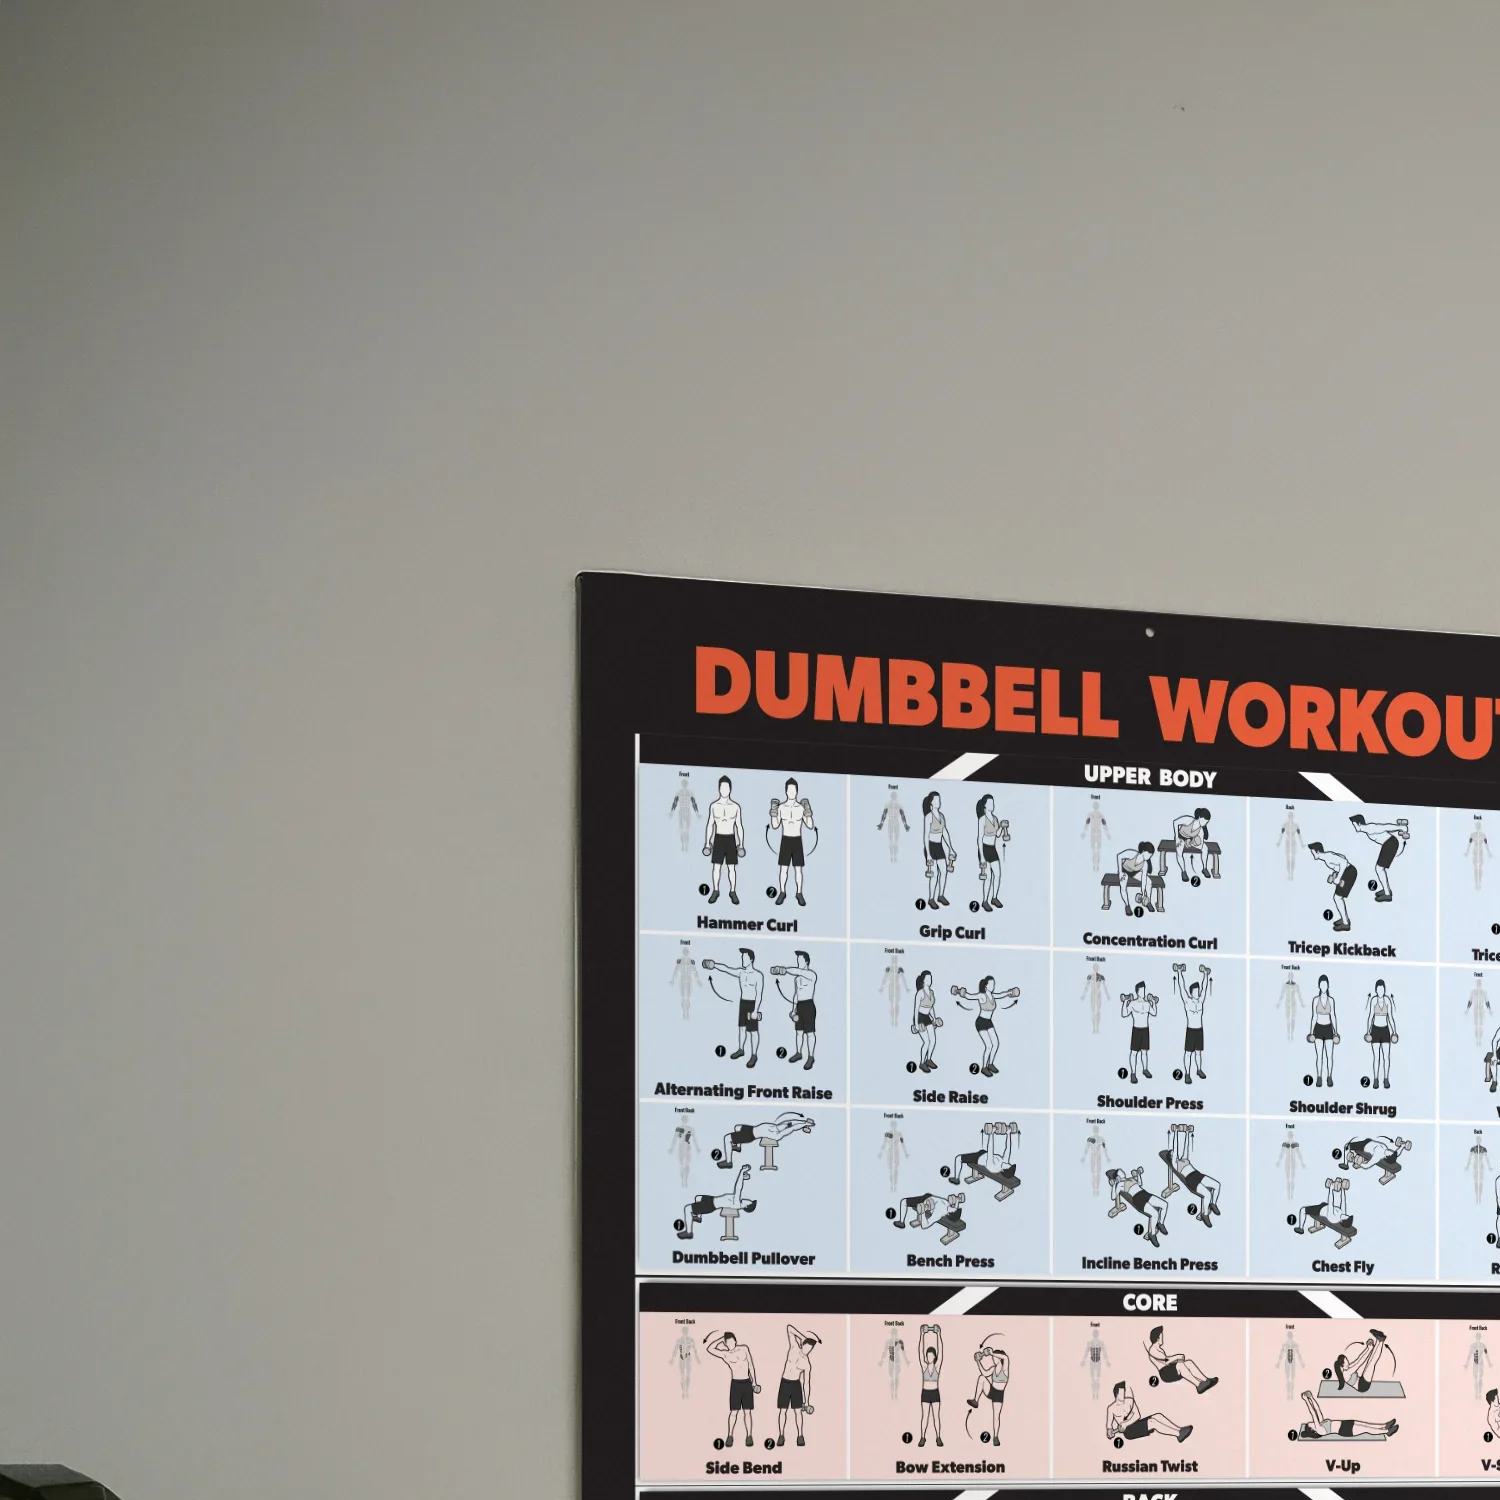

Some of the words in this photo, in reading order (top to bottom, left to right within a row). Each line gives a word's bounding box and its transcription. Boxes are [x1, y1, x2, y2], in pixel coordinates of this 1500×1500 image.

[696, 646, 1119, 738] DUMBBELL
[1084, 764, 1151, 785] UPPER
[1160, 769, 1217, 789] BODY
[697, 915, 764, 931] Hammer
[766, 918, 798, 932] Curl
[919, 924, 952, 941] Grip
[955, 926, 985, 940] Curl
[1083, 932, 1186, 948] Concentration
[1188, 936, 1218, 950] Curl
[1288, 940, 1331, 957] Tricep
[1333, 942, 1396, 957] Kickback
[654, 1082, 744, 1100] Alternating
[748, 1085, 789, 1099] Front
[792, 1086, 833, 1100] Raise
[913, 1089, 946, 1103] Side
[949, 1090, 989, 1104] Raise
[1097, 1095, 1163, 1109] Shoulder
[1166, 1097, 1204, 1110] Press
[1289, 1100, 1353, 1114] Shoulder
[1355, 1102, 1397, 1118] Shrug
[672, 1250, 748, 1264] Dumbbell
[752, 1252, 816, 1265] Pullover
[907, 1254, 952, 1267] Bench
[956, 1255, 995, 1268] Press
[1082, 1256, 1131, 1270] Incline
[1133, 1257, 1177, 1270] Bench
[1180, 1258, 1218, 1271] Press
[1312, 1260, 1351, 1273] Chest
[1354, 1260, 1375, 1276] Fly
[1123, 1293, 1177, 1311] CORE
[706, 1460, 740, 1474] Side
[743, 1461, 782, 1474] Bend
[896, 1461, 929, 1474] Bow
[932, 1460, 1005, 1473] Extension
[1102, 1459, 1158, 1473] Russian
[1160, 1459, 1198, 1472] Twist
[1325, 1459, 1361, 1474] V-Up
